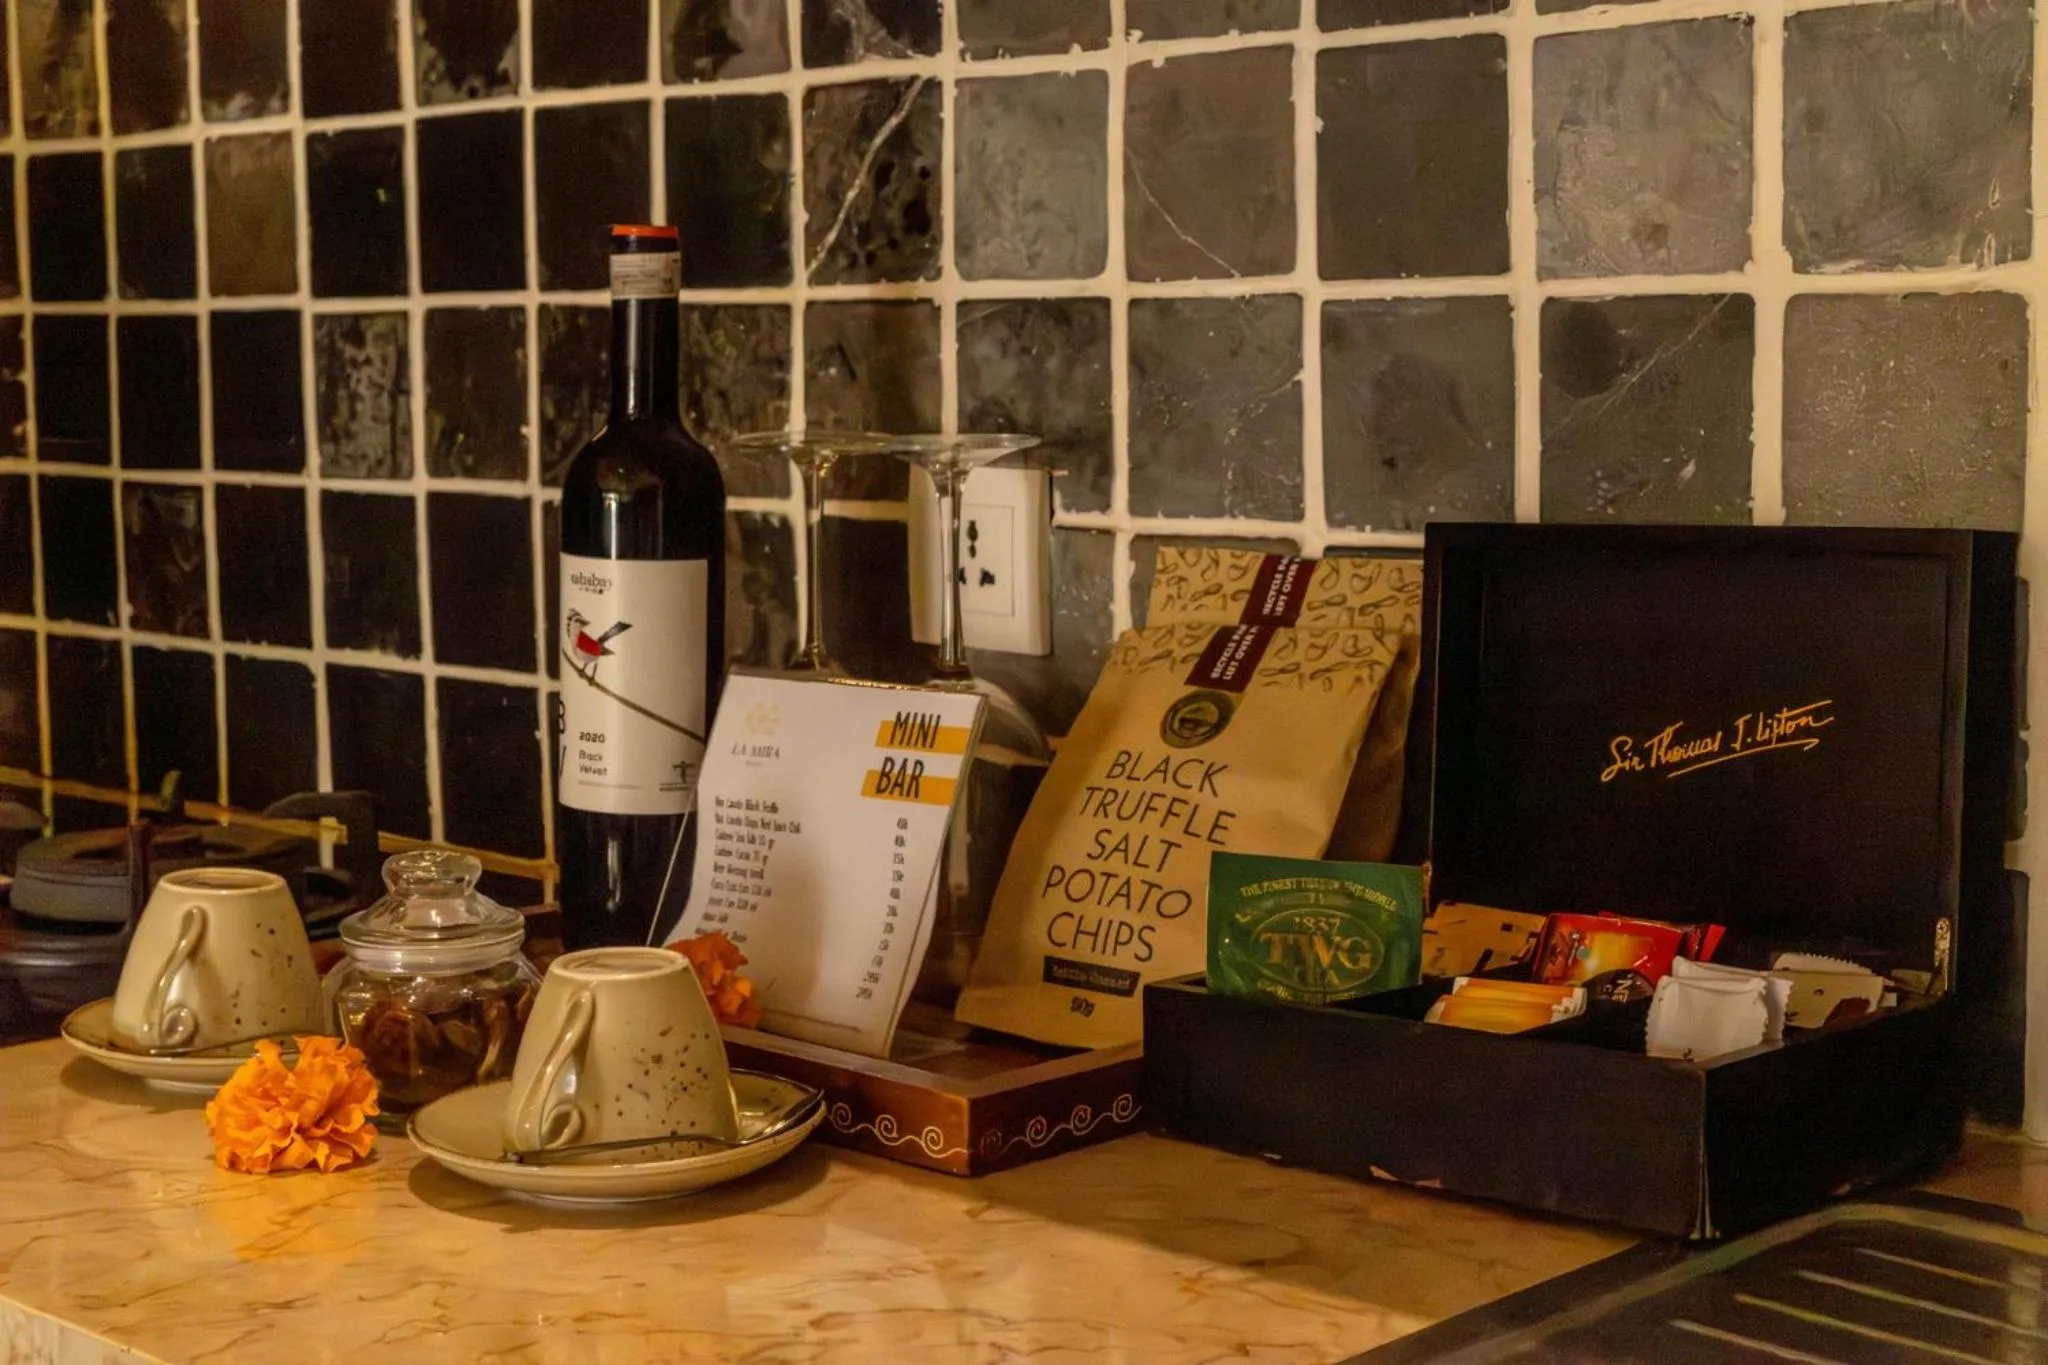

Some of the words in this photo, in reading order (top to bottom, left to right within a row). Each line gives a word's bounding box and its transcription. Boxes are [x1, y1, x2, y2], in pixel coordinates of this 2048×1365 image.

[578, 731, 607, 744] 2020
[889, 711, 941, 749] MINI
[875, 756, 925, 799] BAR
[1105, 750, 1229, 798] BLACK
[1600, 735, 1645, 783] Sir
[1078, 785, 1237, 846] TRUFFLE
[1086, 827, 1182, 874] SALT
[1041, 864, 1193, 919] POTATO
[1046, 910, 1156, 963] CHIPS
[1259, 931, 1373, 970] TWG
